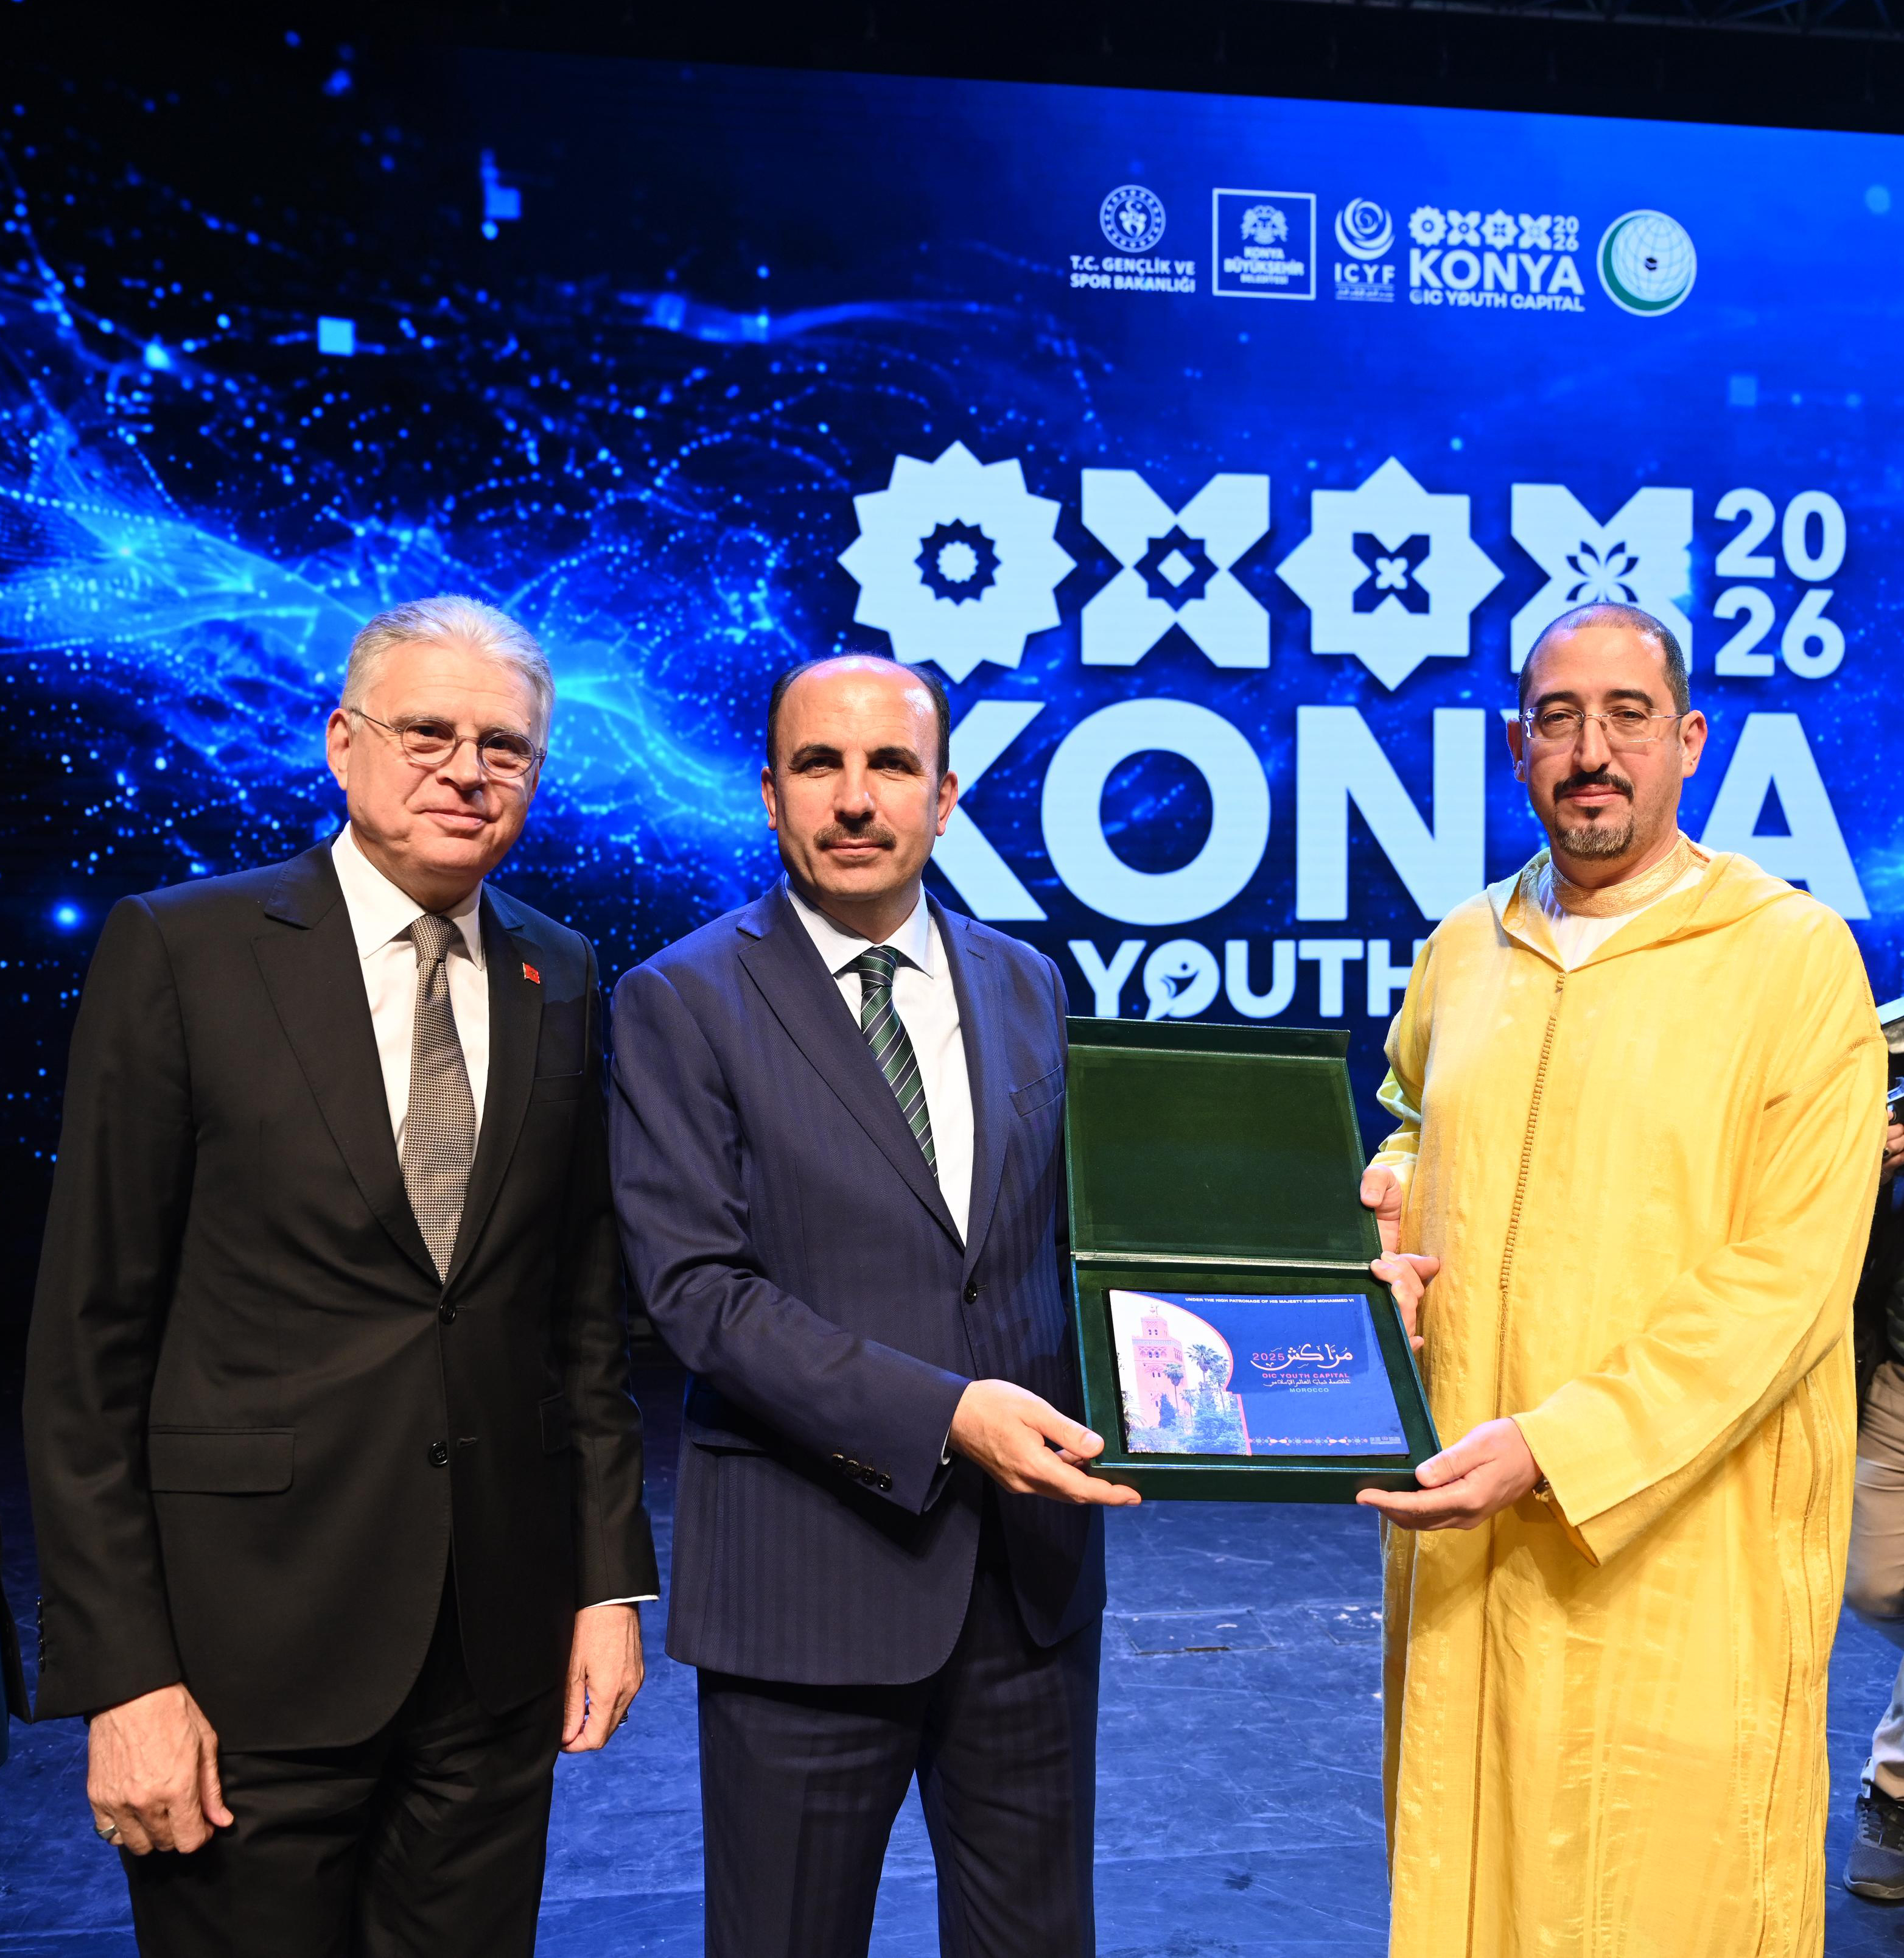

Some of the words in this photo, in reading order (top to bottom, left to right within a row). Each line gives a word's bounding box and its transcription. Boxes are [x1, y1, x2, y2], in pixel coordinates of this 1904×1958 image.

[1553, 215, 1580, 234] 20
[1553, 233, 1580, 252] 26
[1069, 255, 1099, 271] T.C.
[1102, 256, 1171, 276] GENÇLİK
[1174, 260, 1195, 275] VE
[1334, 262, 1396, 285] ICYF
[1409, 248, 1585, 295] KONYA
[1070, 273, 1111, 289] SPOR
[1113, 275, 1195, 293] BAKANLIĞI
[1445, 290, 1507, 308] YOUTH
[1510, 293, 1586, 312] CAPITAL
[1714, 487, 1847, 582] 20
[1713, 585, 1846, 679] 26
[930, 697, 1872, 927] KONA
[1252, 1352, 1285, 1361] 2025
